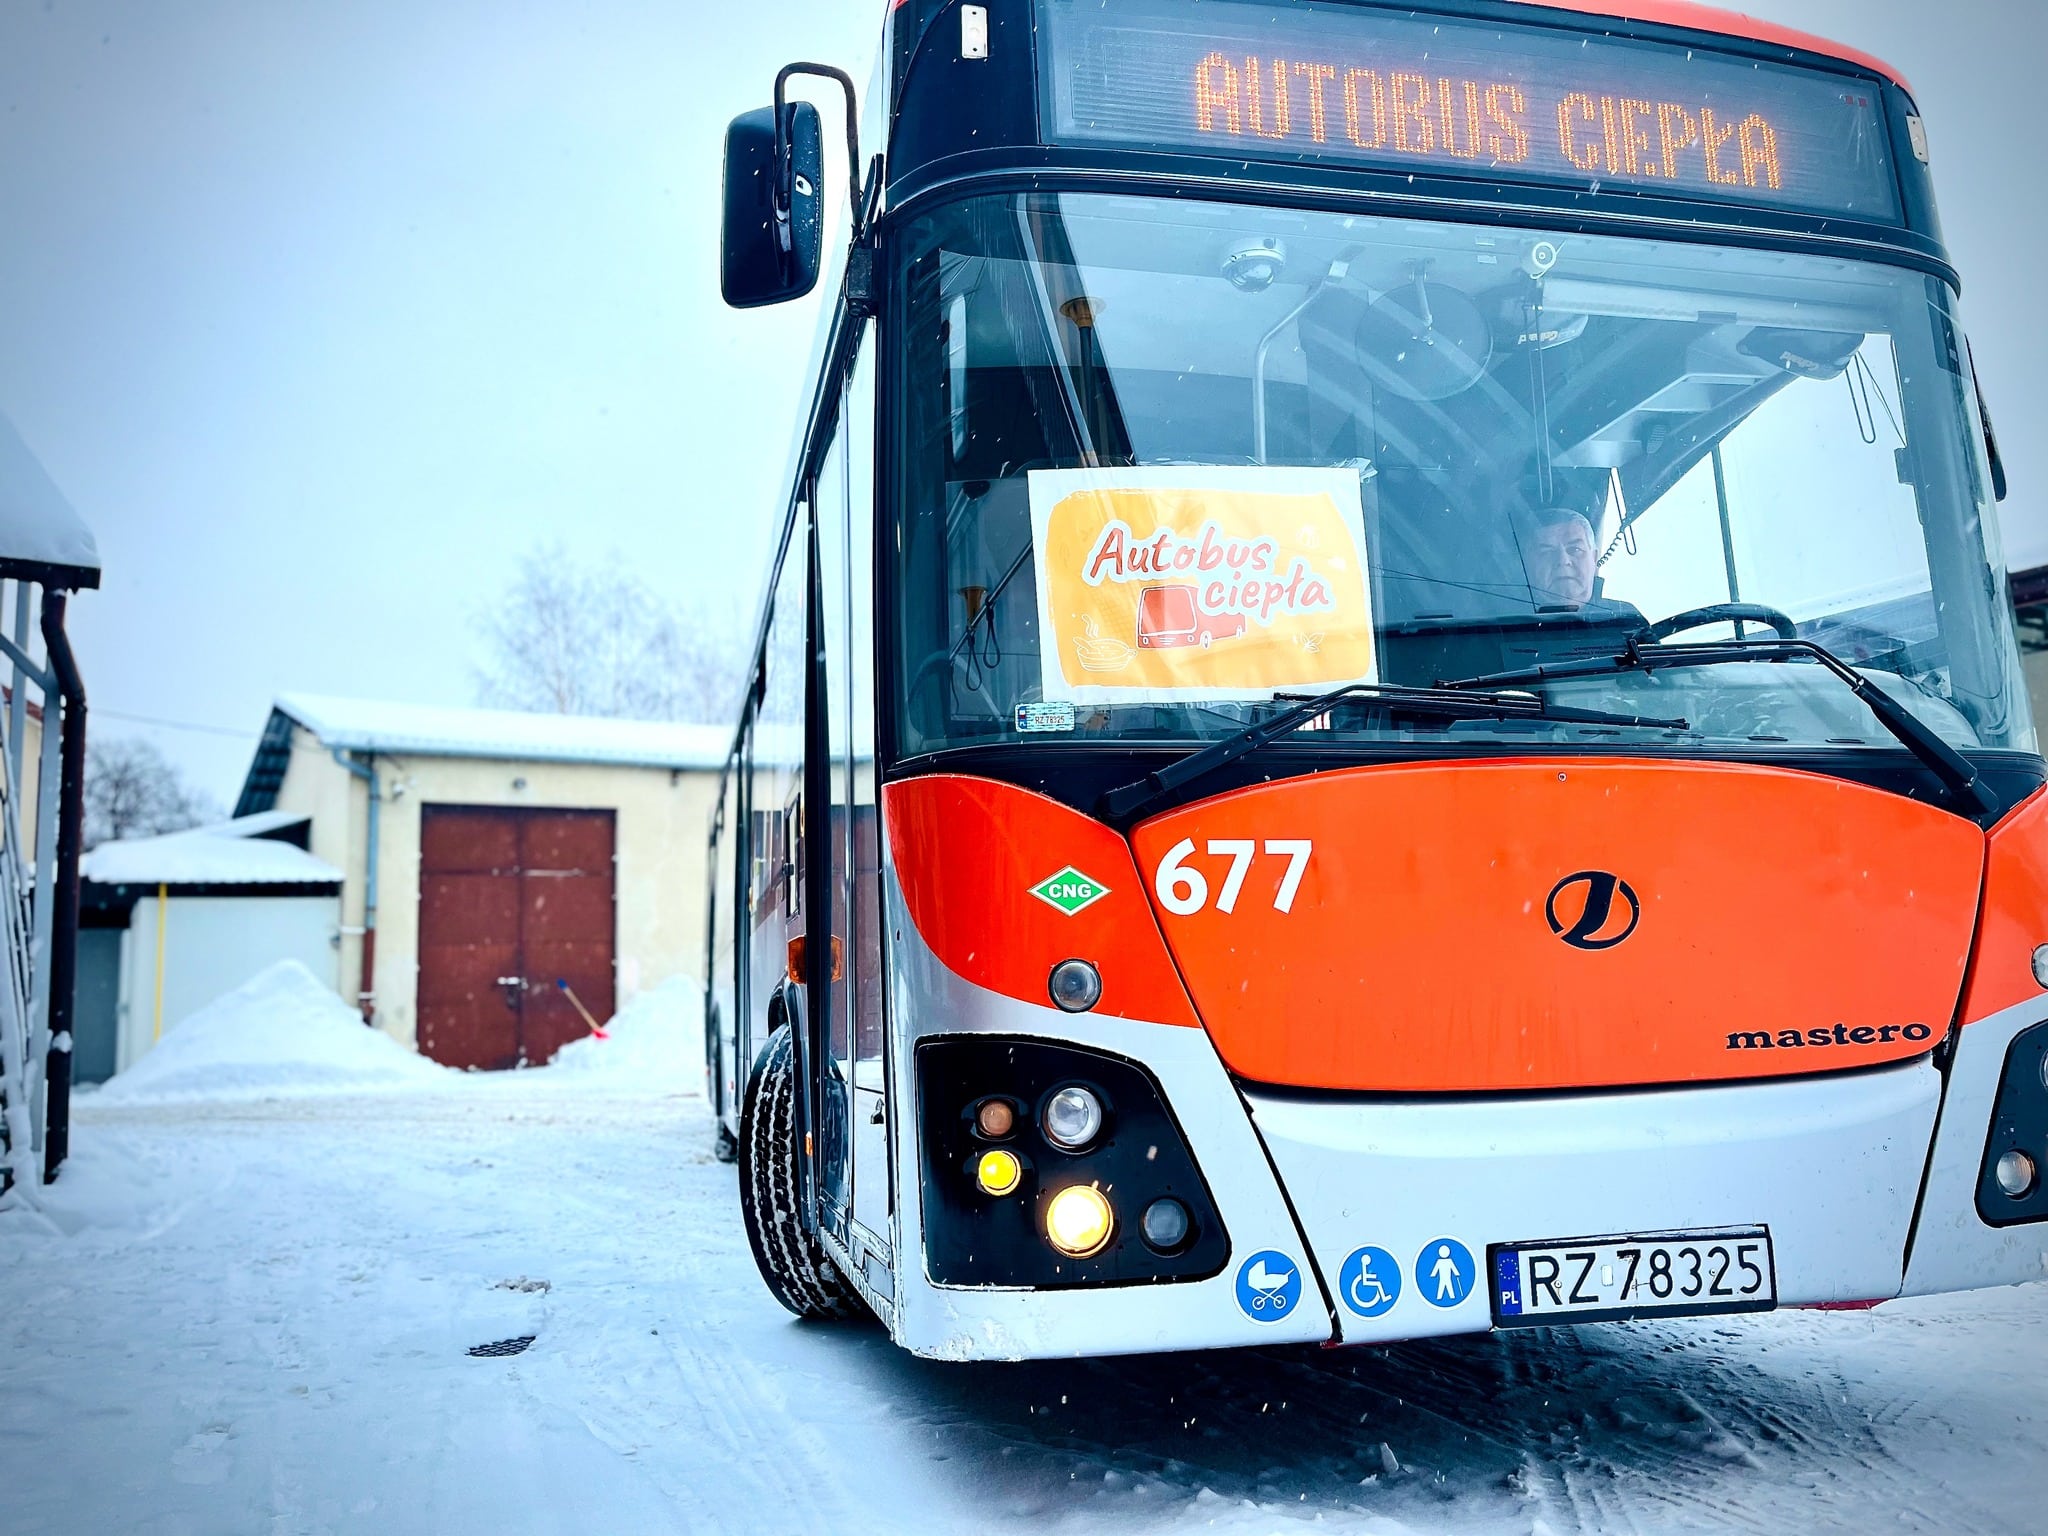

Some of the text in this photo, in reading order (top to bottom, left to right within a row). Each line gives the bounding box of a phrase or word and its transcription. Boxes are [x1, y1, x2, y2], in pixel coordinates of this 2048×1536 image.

[1195, 52, 1781, 190] AUTOBUS CIEPŁA
[1089, 526, 1272, 579] Autobus
[1204, 564, 1330, 620] ciepła
[1048, 883, 1092, 899] CNG
[1155, 837, 1313, 916] 677
[1726, 1023, 1932, 1050] mastero
[1502, 1291, 1519, 1305] PL
[1528, 1244, 1763, 1307] RZ 78325
